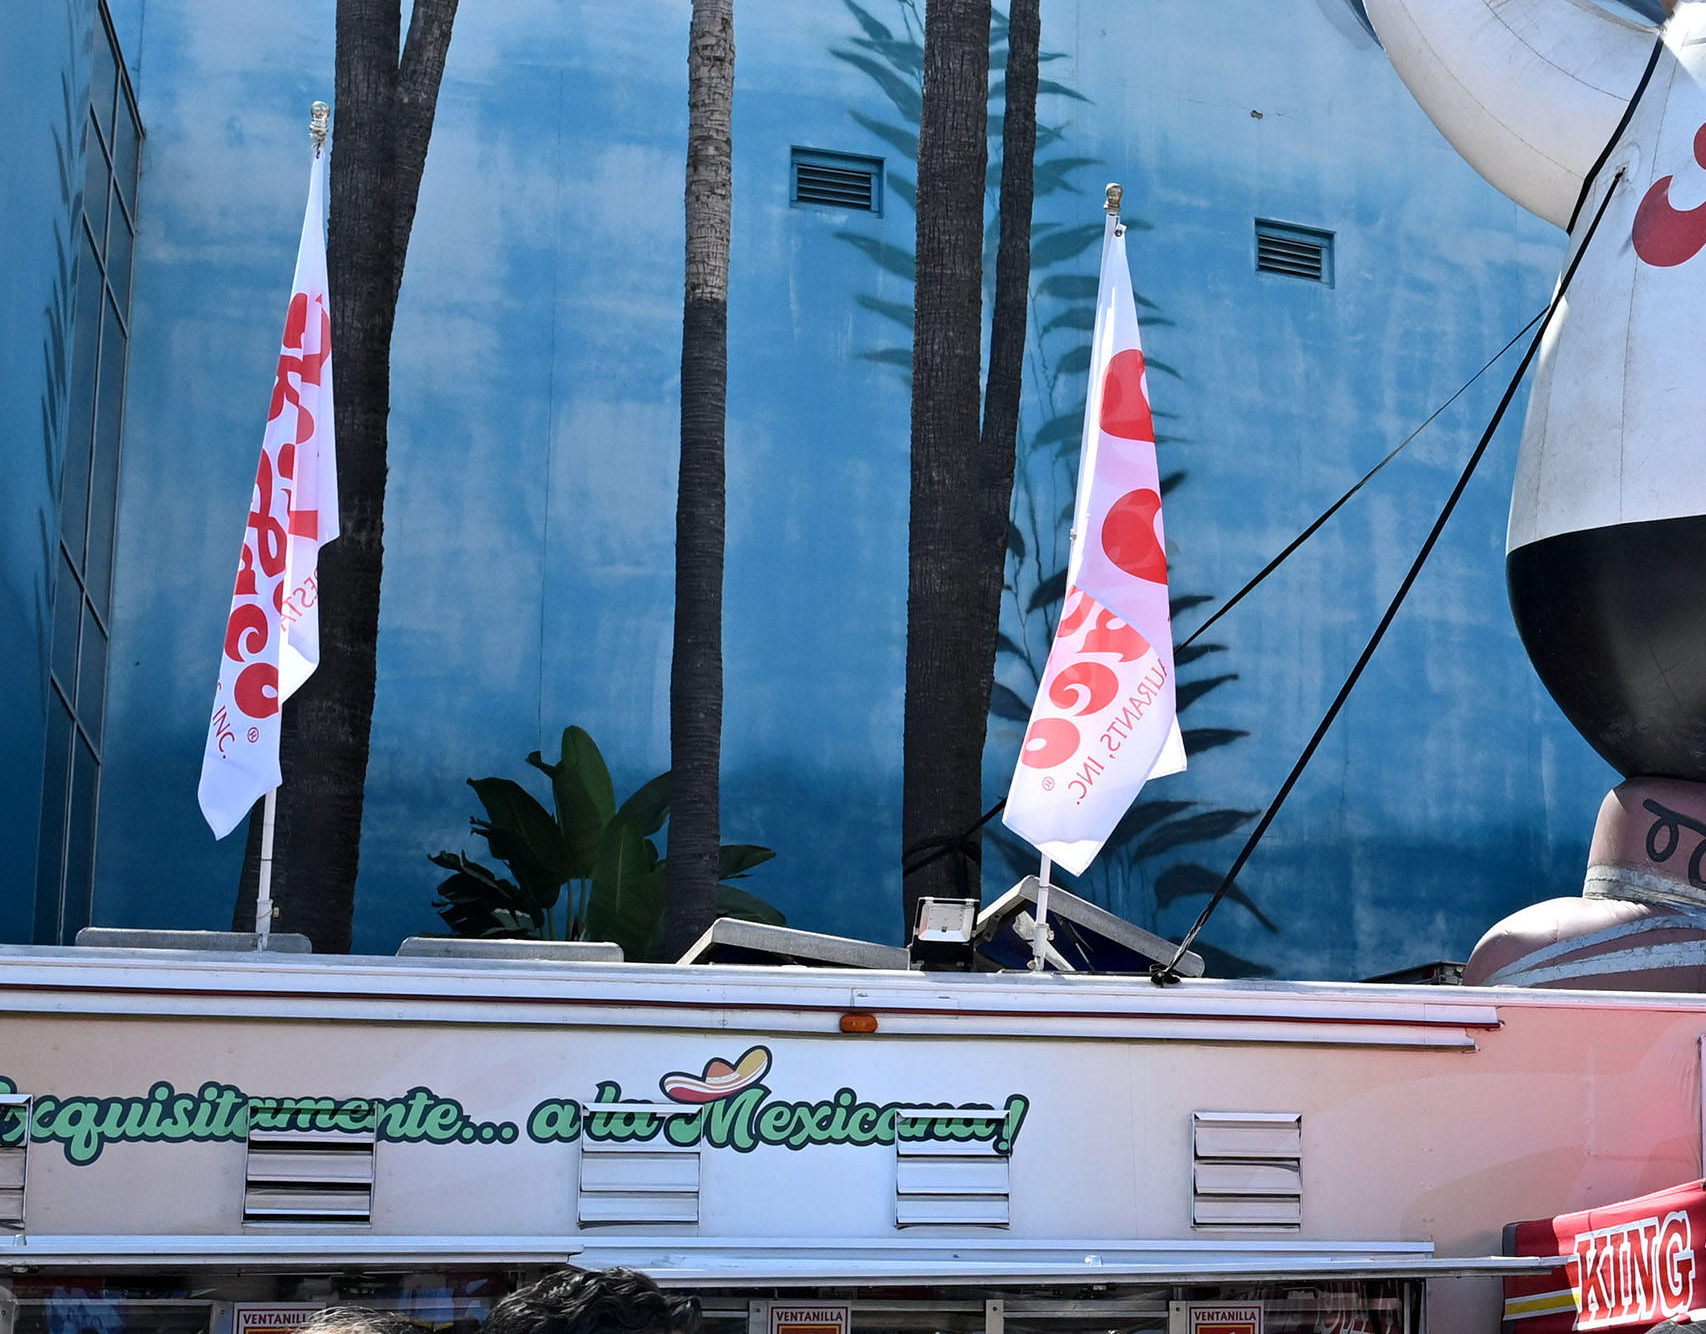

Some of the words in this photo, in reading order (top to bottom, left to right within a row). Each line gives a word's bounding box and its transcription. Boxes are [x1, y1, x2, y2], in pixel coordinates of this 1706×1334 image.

[0, 1075, 520, 1167] xquisitamente...
[525, 1098, 585, 1145] a
[586, 1080, 662, 1145] la
[662, 1081, 1030, 1155] Mexicana!
[1572, 1209, 1696, 1332] KING
[243, 1313, 308, 1325] VENTANILL
[776, 1311, 844, 1322] VENTANILLA
[1193, 1310, 1257, 1322] VENTANILLA
